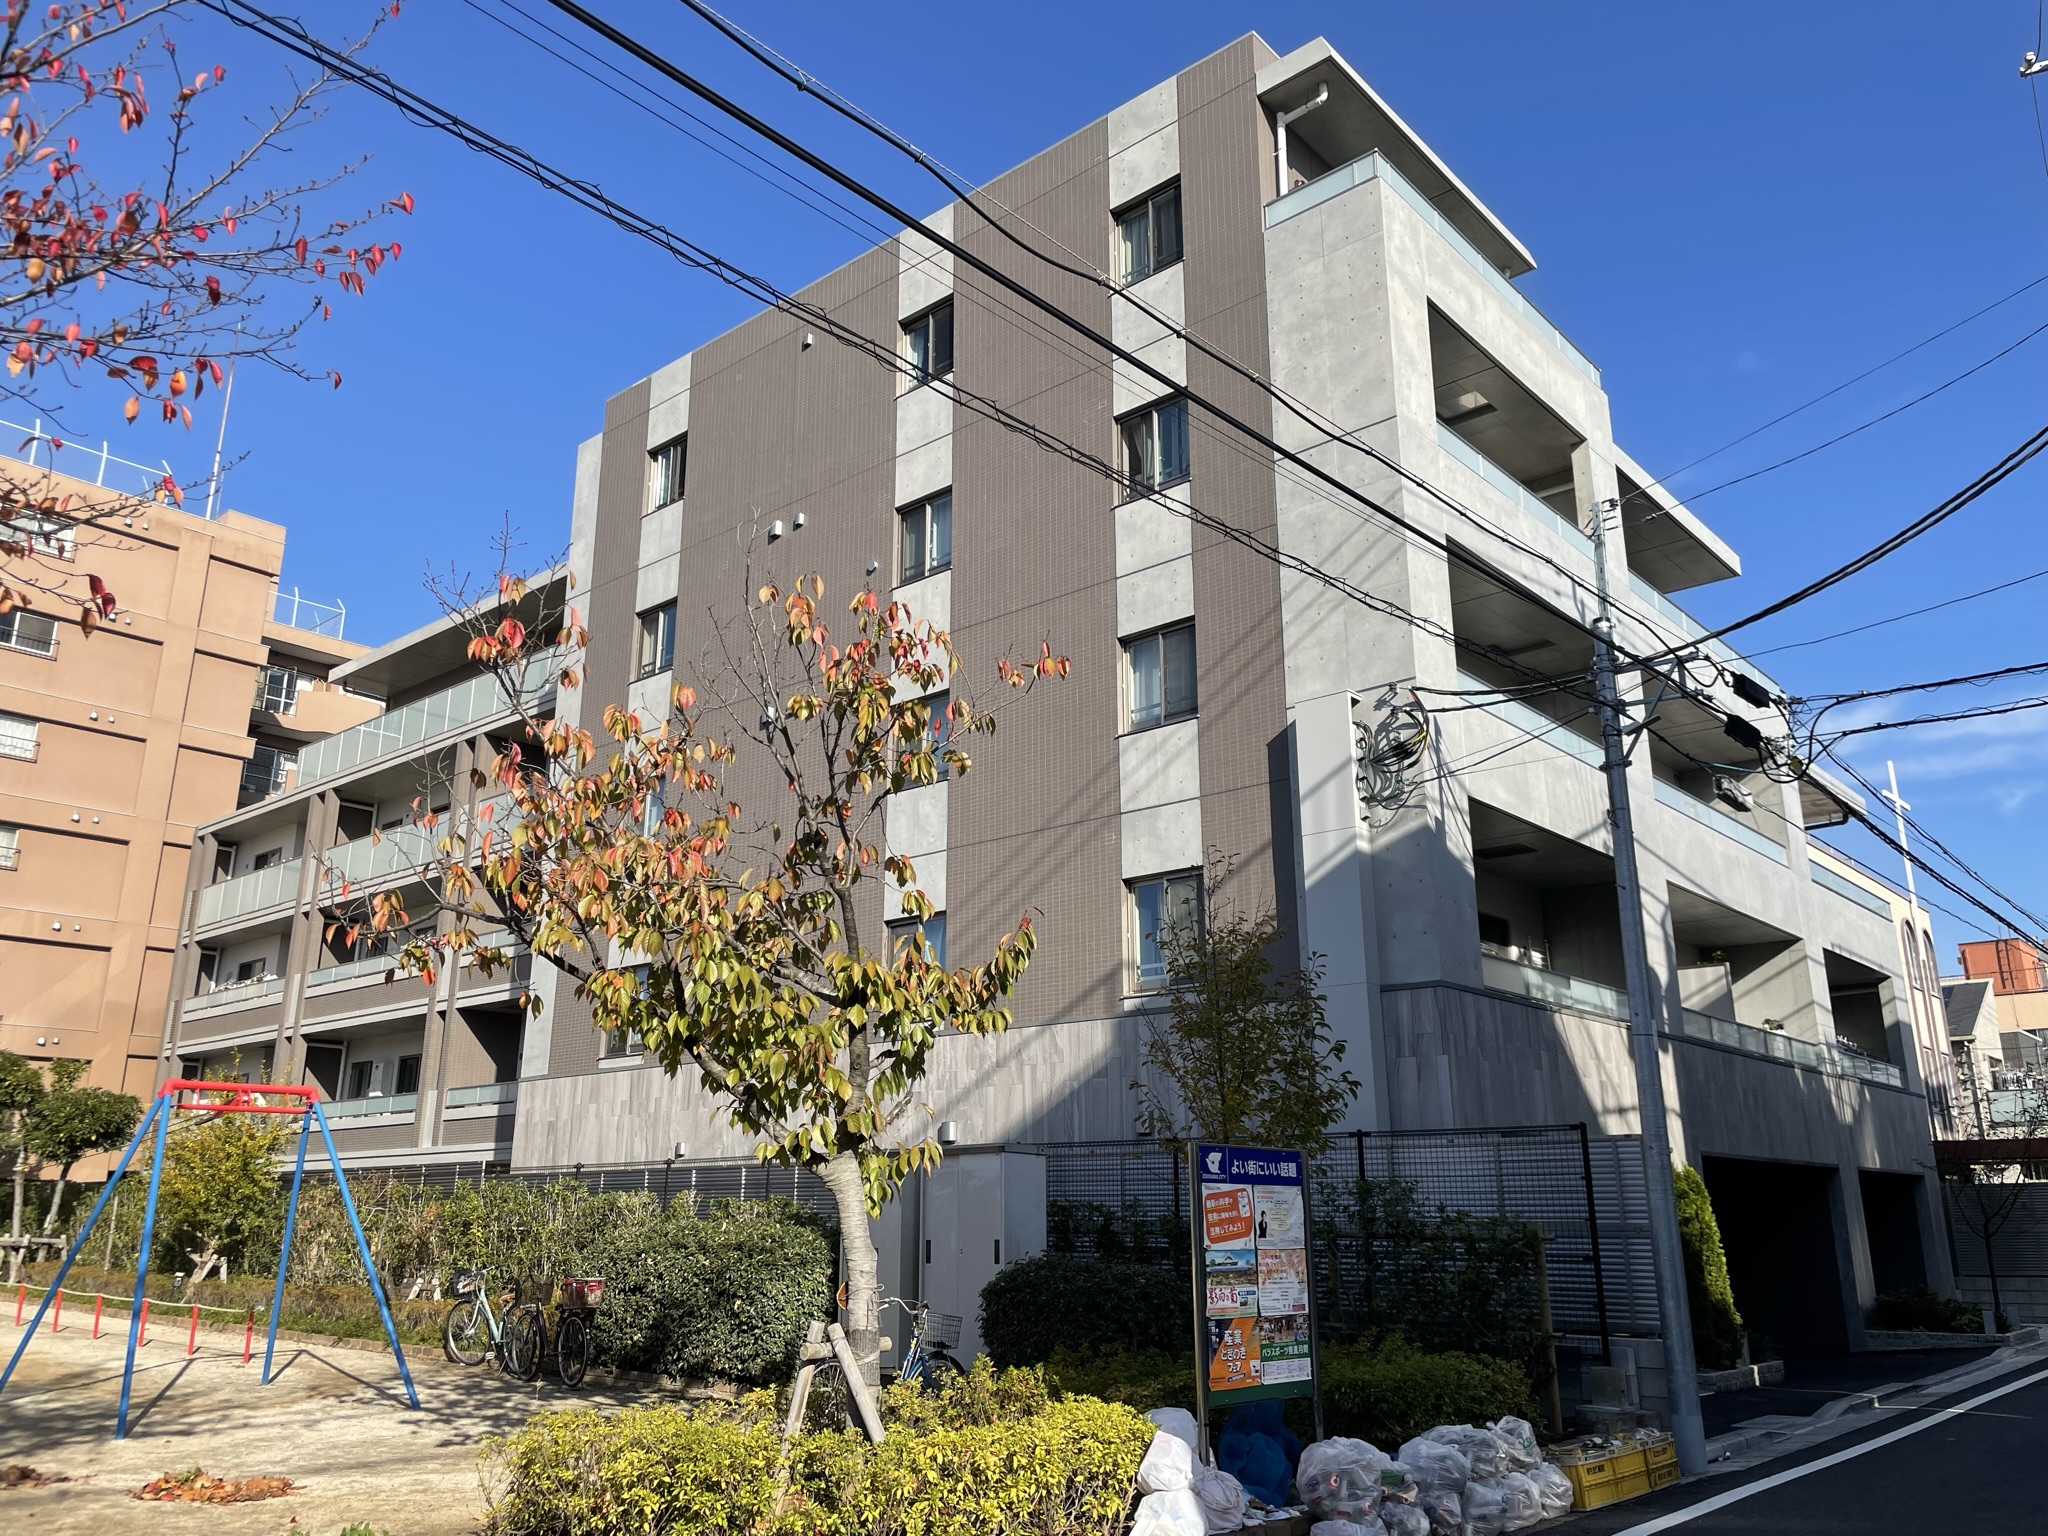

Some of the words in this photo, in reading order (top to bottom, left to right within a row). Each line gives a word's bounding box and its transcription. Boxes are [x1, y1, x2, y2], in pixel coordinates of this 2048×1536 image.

[1231, 1159, 1297, 1177] よい街にいい話題
[1224, 1329, 1242, 1346] 産業
